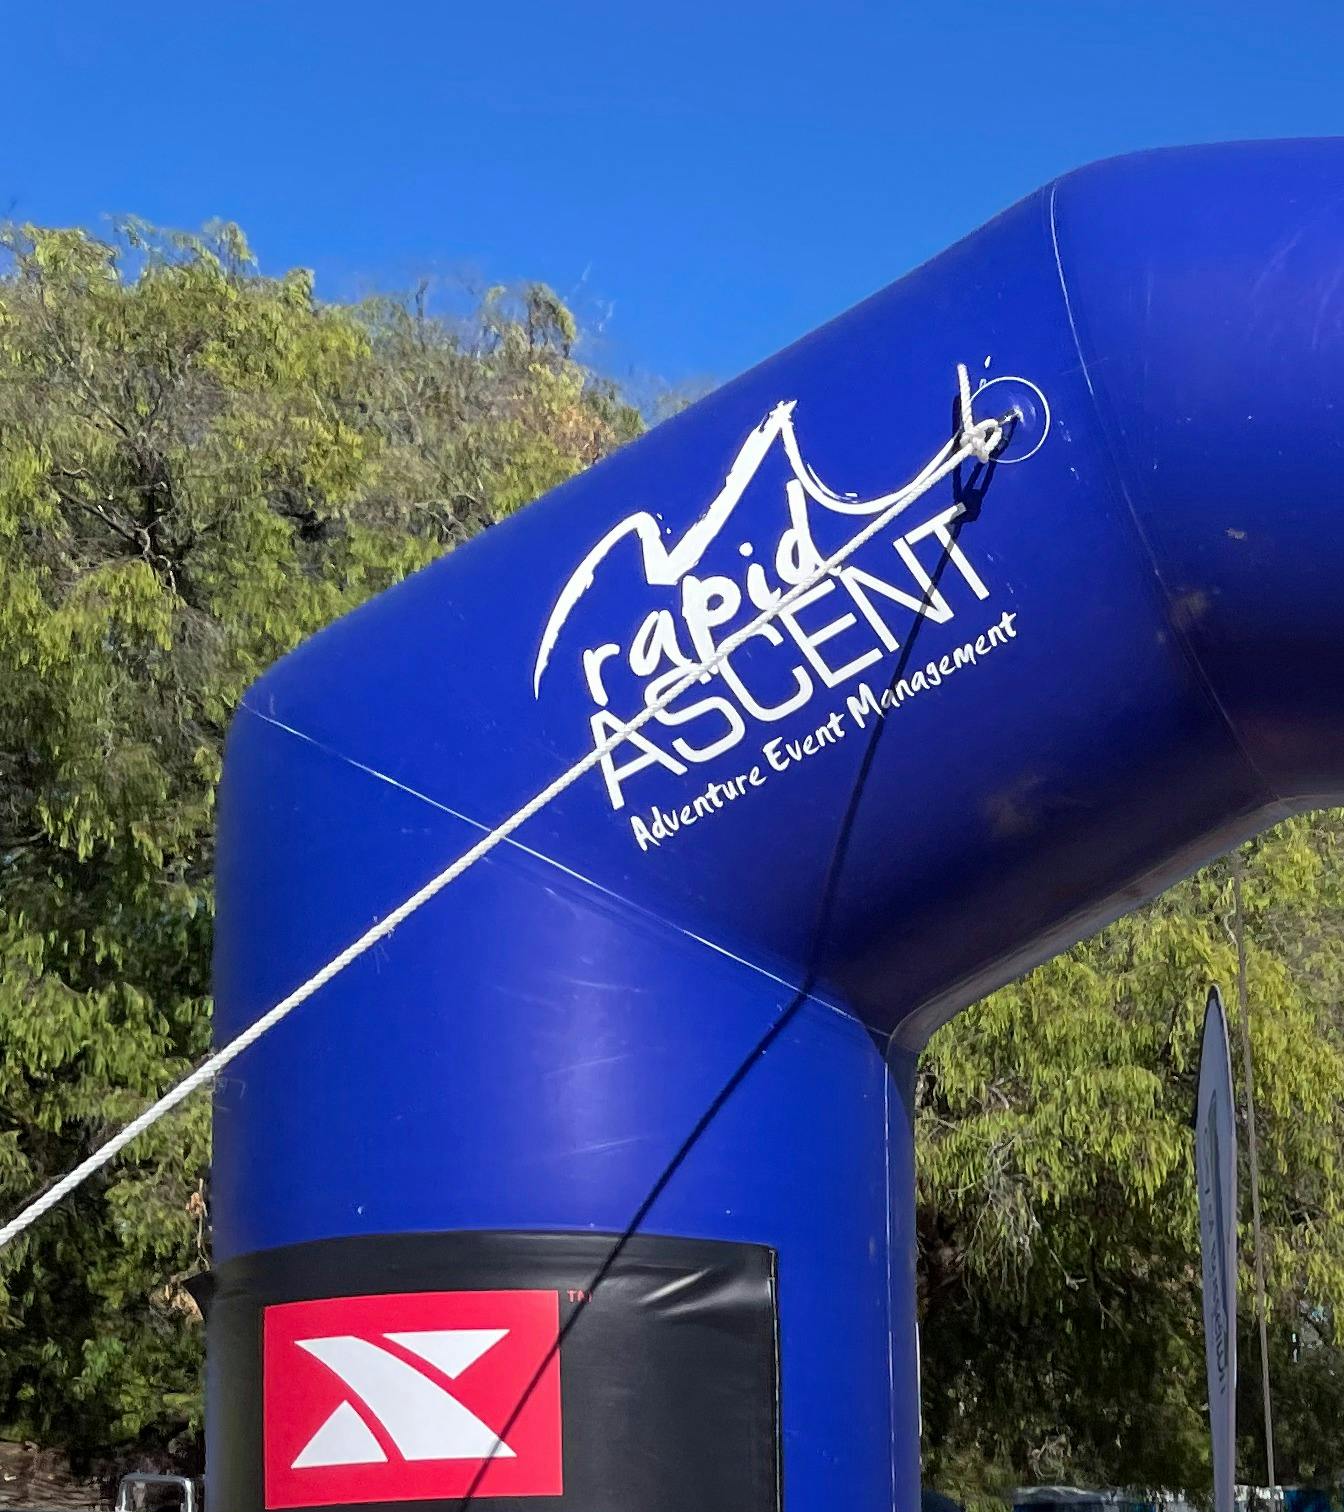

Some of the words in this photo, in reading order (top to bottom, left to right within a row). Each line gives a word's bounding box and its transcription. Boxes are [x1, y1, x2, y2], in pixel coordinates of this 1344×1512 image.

[590, 502, 990, 810] ASCENT
[628, 764, 767, 851] Adventure
[762, 711, 846, 773] Event
[848, 611, 1018, 729] Management
